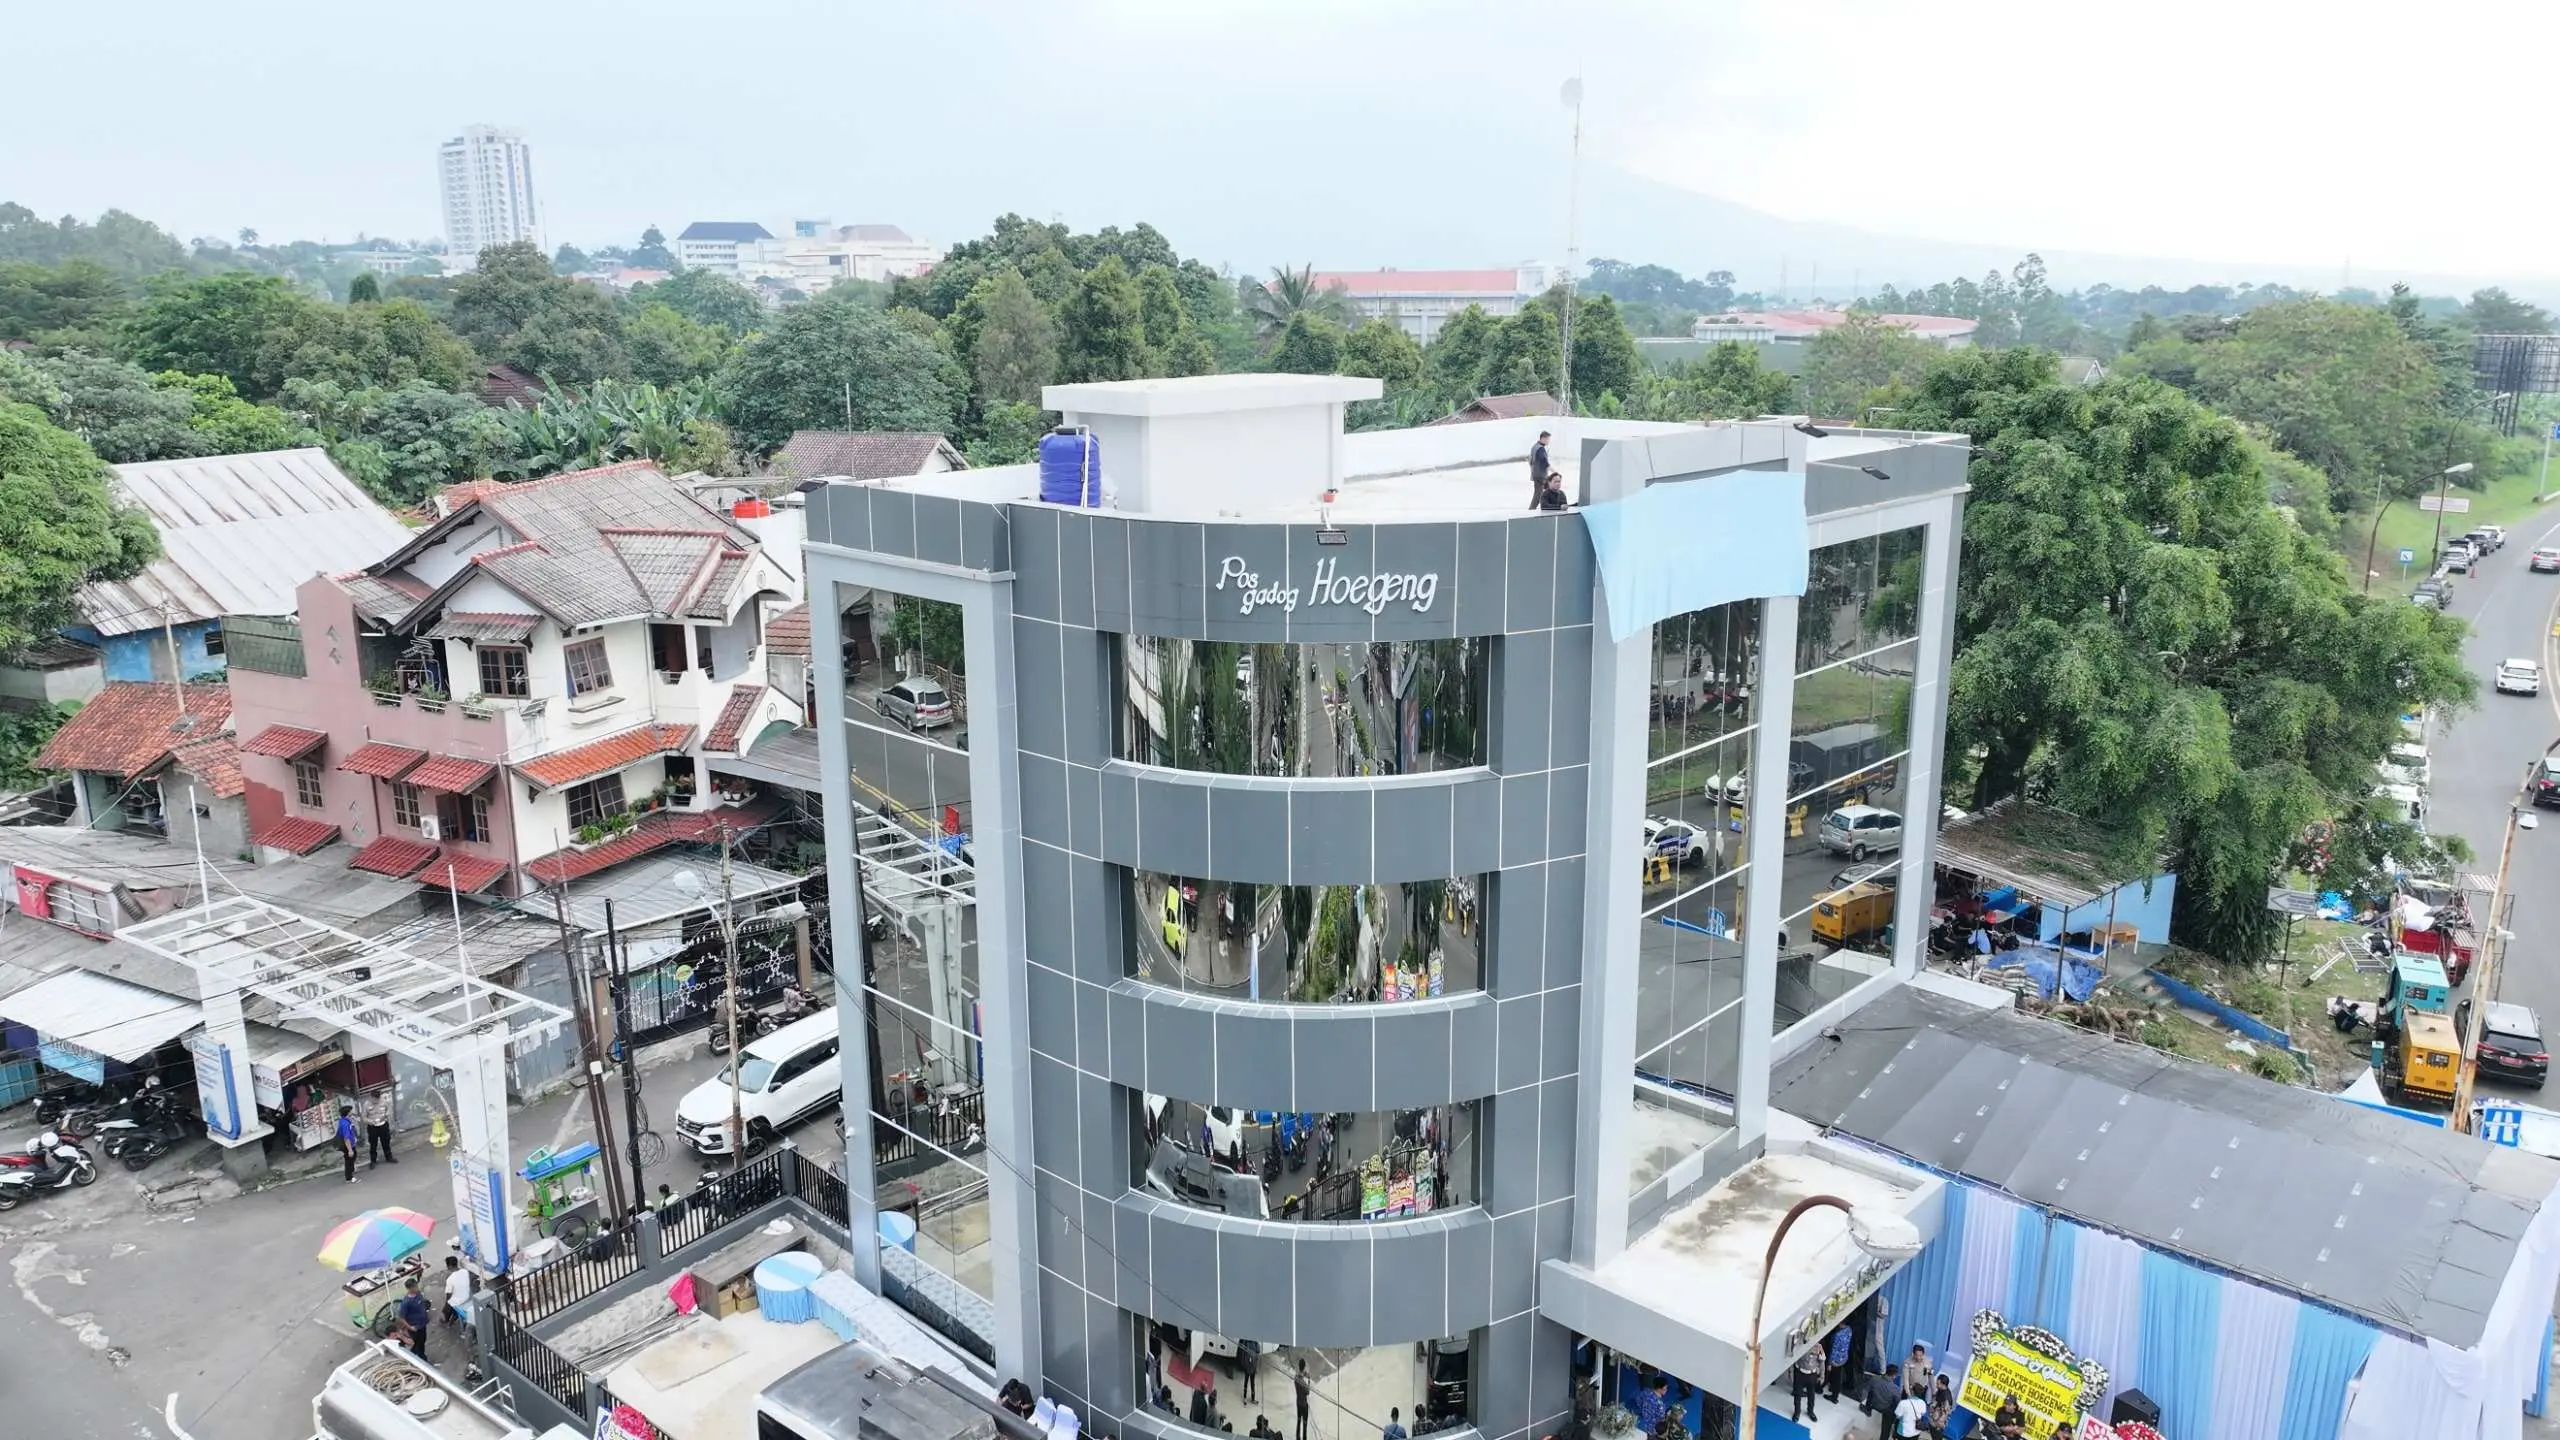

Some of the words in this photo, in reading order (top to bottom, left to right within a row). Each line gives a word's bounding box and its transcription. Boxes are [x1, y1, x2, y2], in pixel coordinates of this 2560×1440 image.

[1215, 556, 1259, 590] Pos
[1308, 556, 1438, 615] Hoegeng
[1240, 581, 1299, 615] gadog
[1999, 1372, 2027, 1393] GADOG
[2027, 1387, 2067, 1413] HOEGENG
[2025, 1398, 2053, 1416] BOGOR
